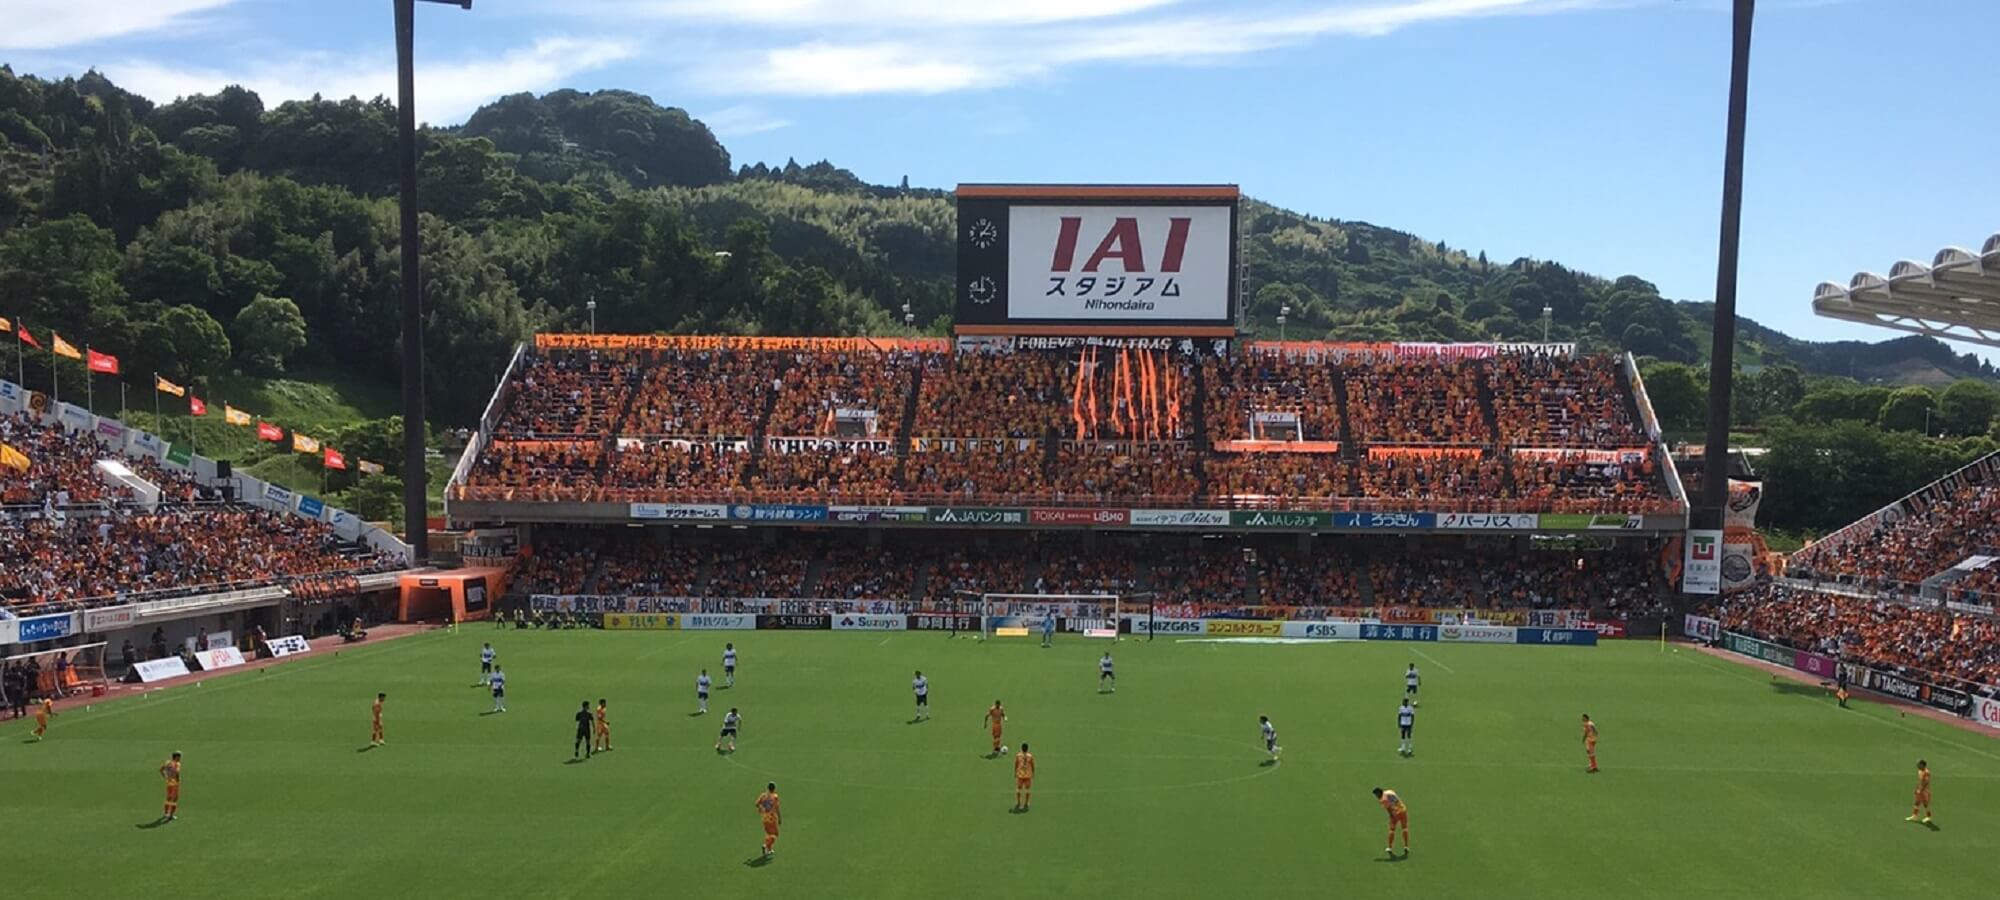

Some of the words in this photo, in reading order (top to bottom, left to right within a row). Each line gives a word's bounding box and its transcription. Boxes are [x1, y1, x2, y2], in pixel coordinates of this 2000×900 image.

[1051, 217, 1191, 273] IAI
[1046, 277, 1180, 297] スタジアム
[1084, 299, 1155, 311] Nihondaira
[1034, 511, 1065, 521] TOKAI
[701, 598, 730, 614] DUKE
[780, 616, 824, 626] S-TRUST
[858, 616, 899, 629] Suzuyo
[1314, 625, 1337, 637] SBS
[1366, 625, 1432, 640] 清水銀行
[1982, 700, 2000, 723] Ca
